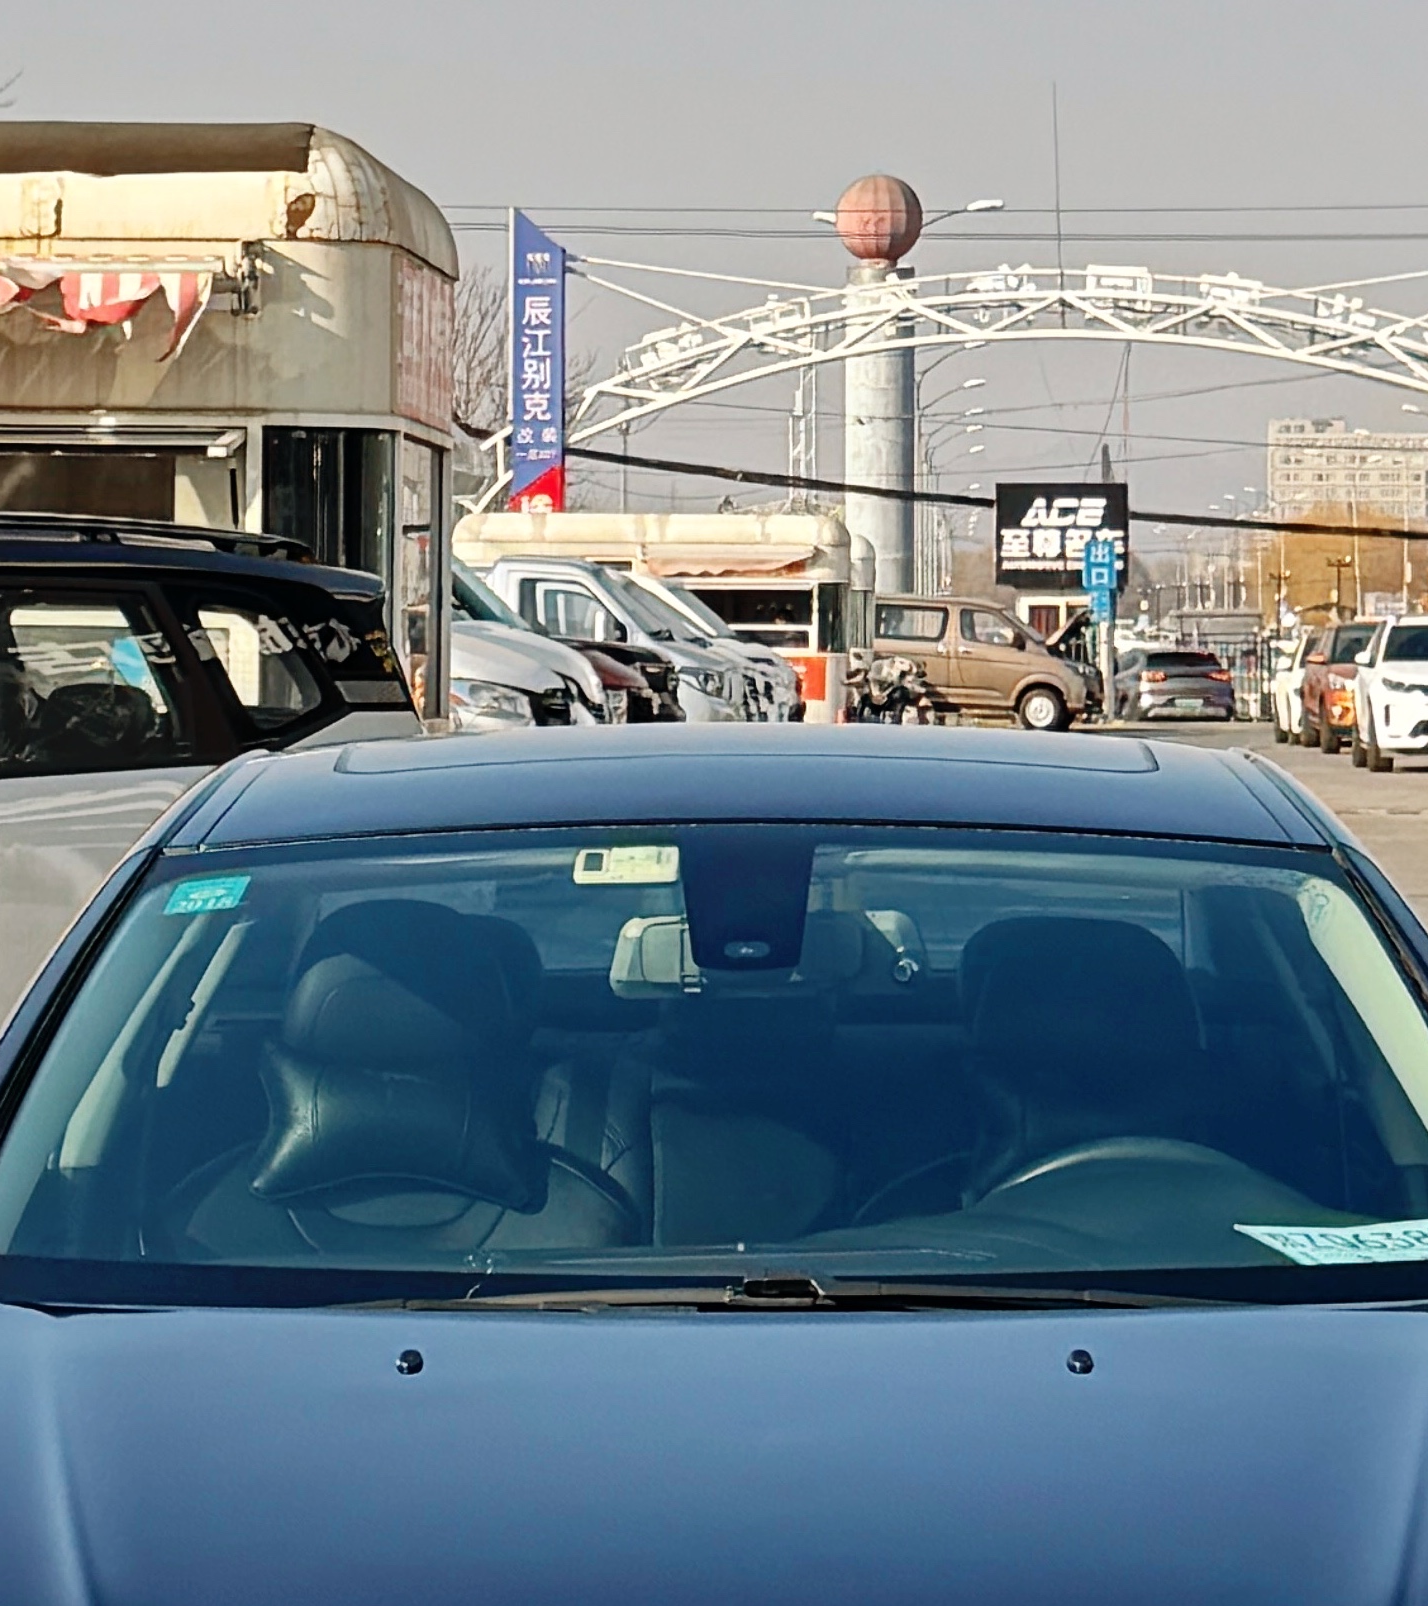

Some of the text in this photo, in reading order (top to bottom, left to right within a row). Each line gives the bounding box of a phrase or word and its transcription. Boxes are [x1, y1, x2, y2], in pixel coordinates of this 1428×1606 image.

[521, 296, 553, 421] 辰江别克
[1020, 496, 1107, 527] ACE
[1090, 543, 1110, 586] 出口
